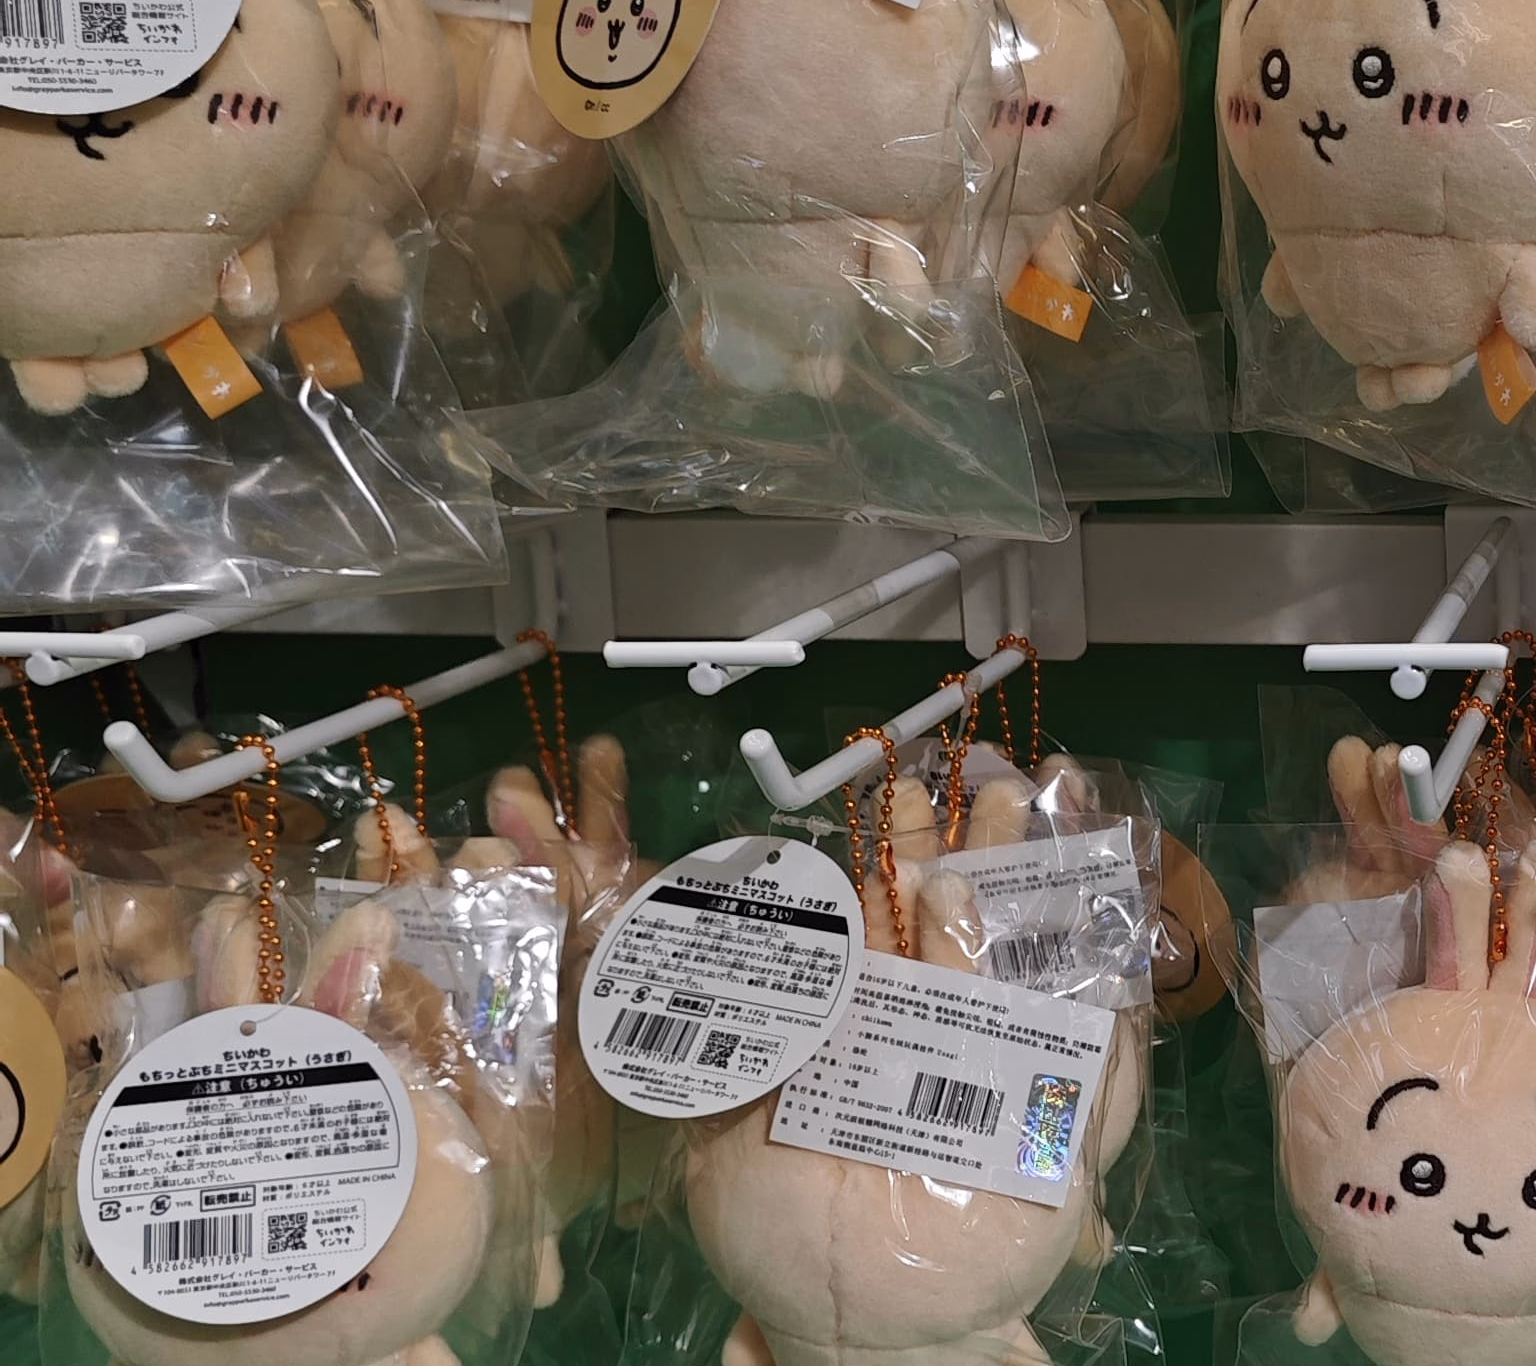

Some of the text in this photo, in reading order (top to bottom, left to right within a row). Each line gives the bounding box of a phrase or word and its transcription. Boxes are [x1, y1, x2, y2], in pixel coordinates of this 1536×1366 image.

[5, 38, 58, 49] 917897
[743, 876, 780, 891] ちいかわ
[223, 1047, 271, 1062] ちいかわ
[205, 1072, 305, 1095] 注意（ちゅうい）
[337, 1176, 361, 1186] MADE
[371, 1172, 396, 1183] CHINA
[204, 1190, 252, 1207] 転売禁止
[130, 1252, 248, 1276] 4 582662 917897
